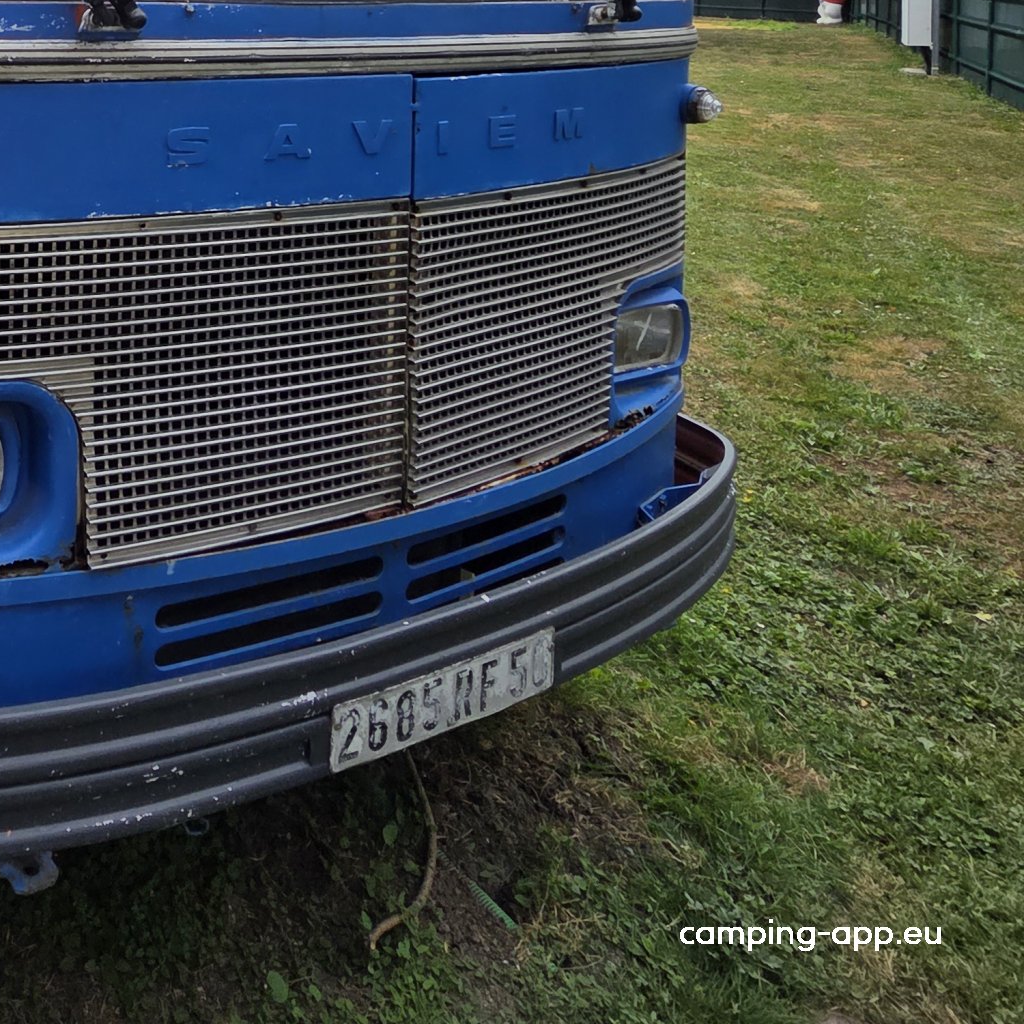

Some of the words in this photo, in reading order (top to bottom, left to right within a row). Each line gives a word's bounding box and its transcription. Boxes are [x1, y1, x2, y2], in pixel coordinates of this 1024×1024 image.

[166, 106, 585, 167] SAVIEM
[338, 677, 442, 763] 2685
[507, 635, 551, 698] 50
